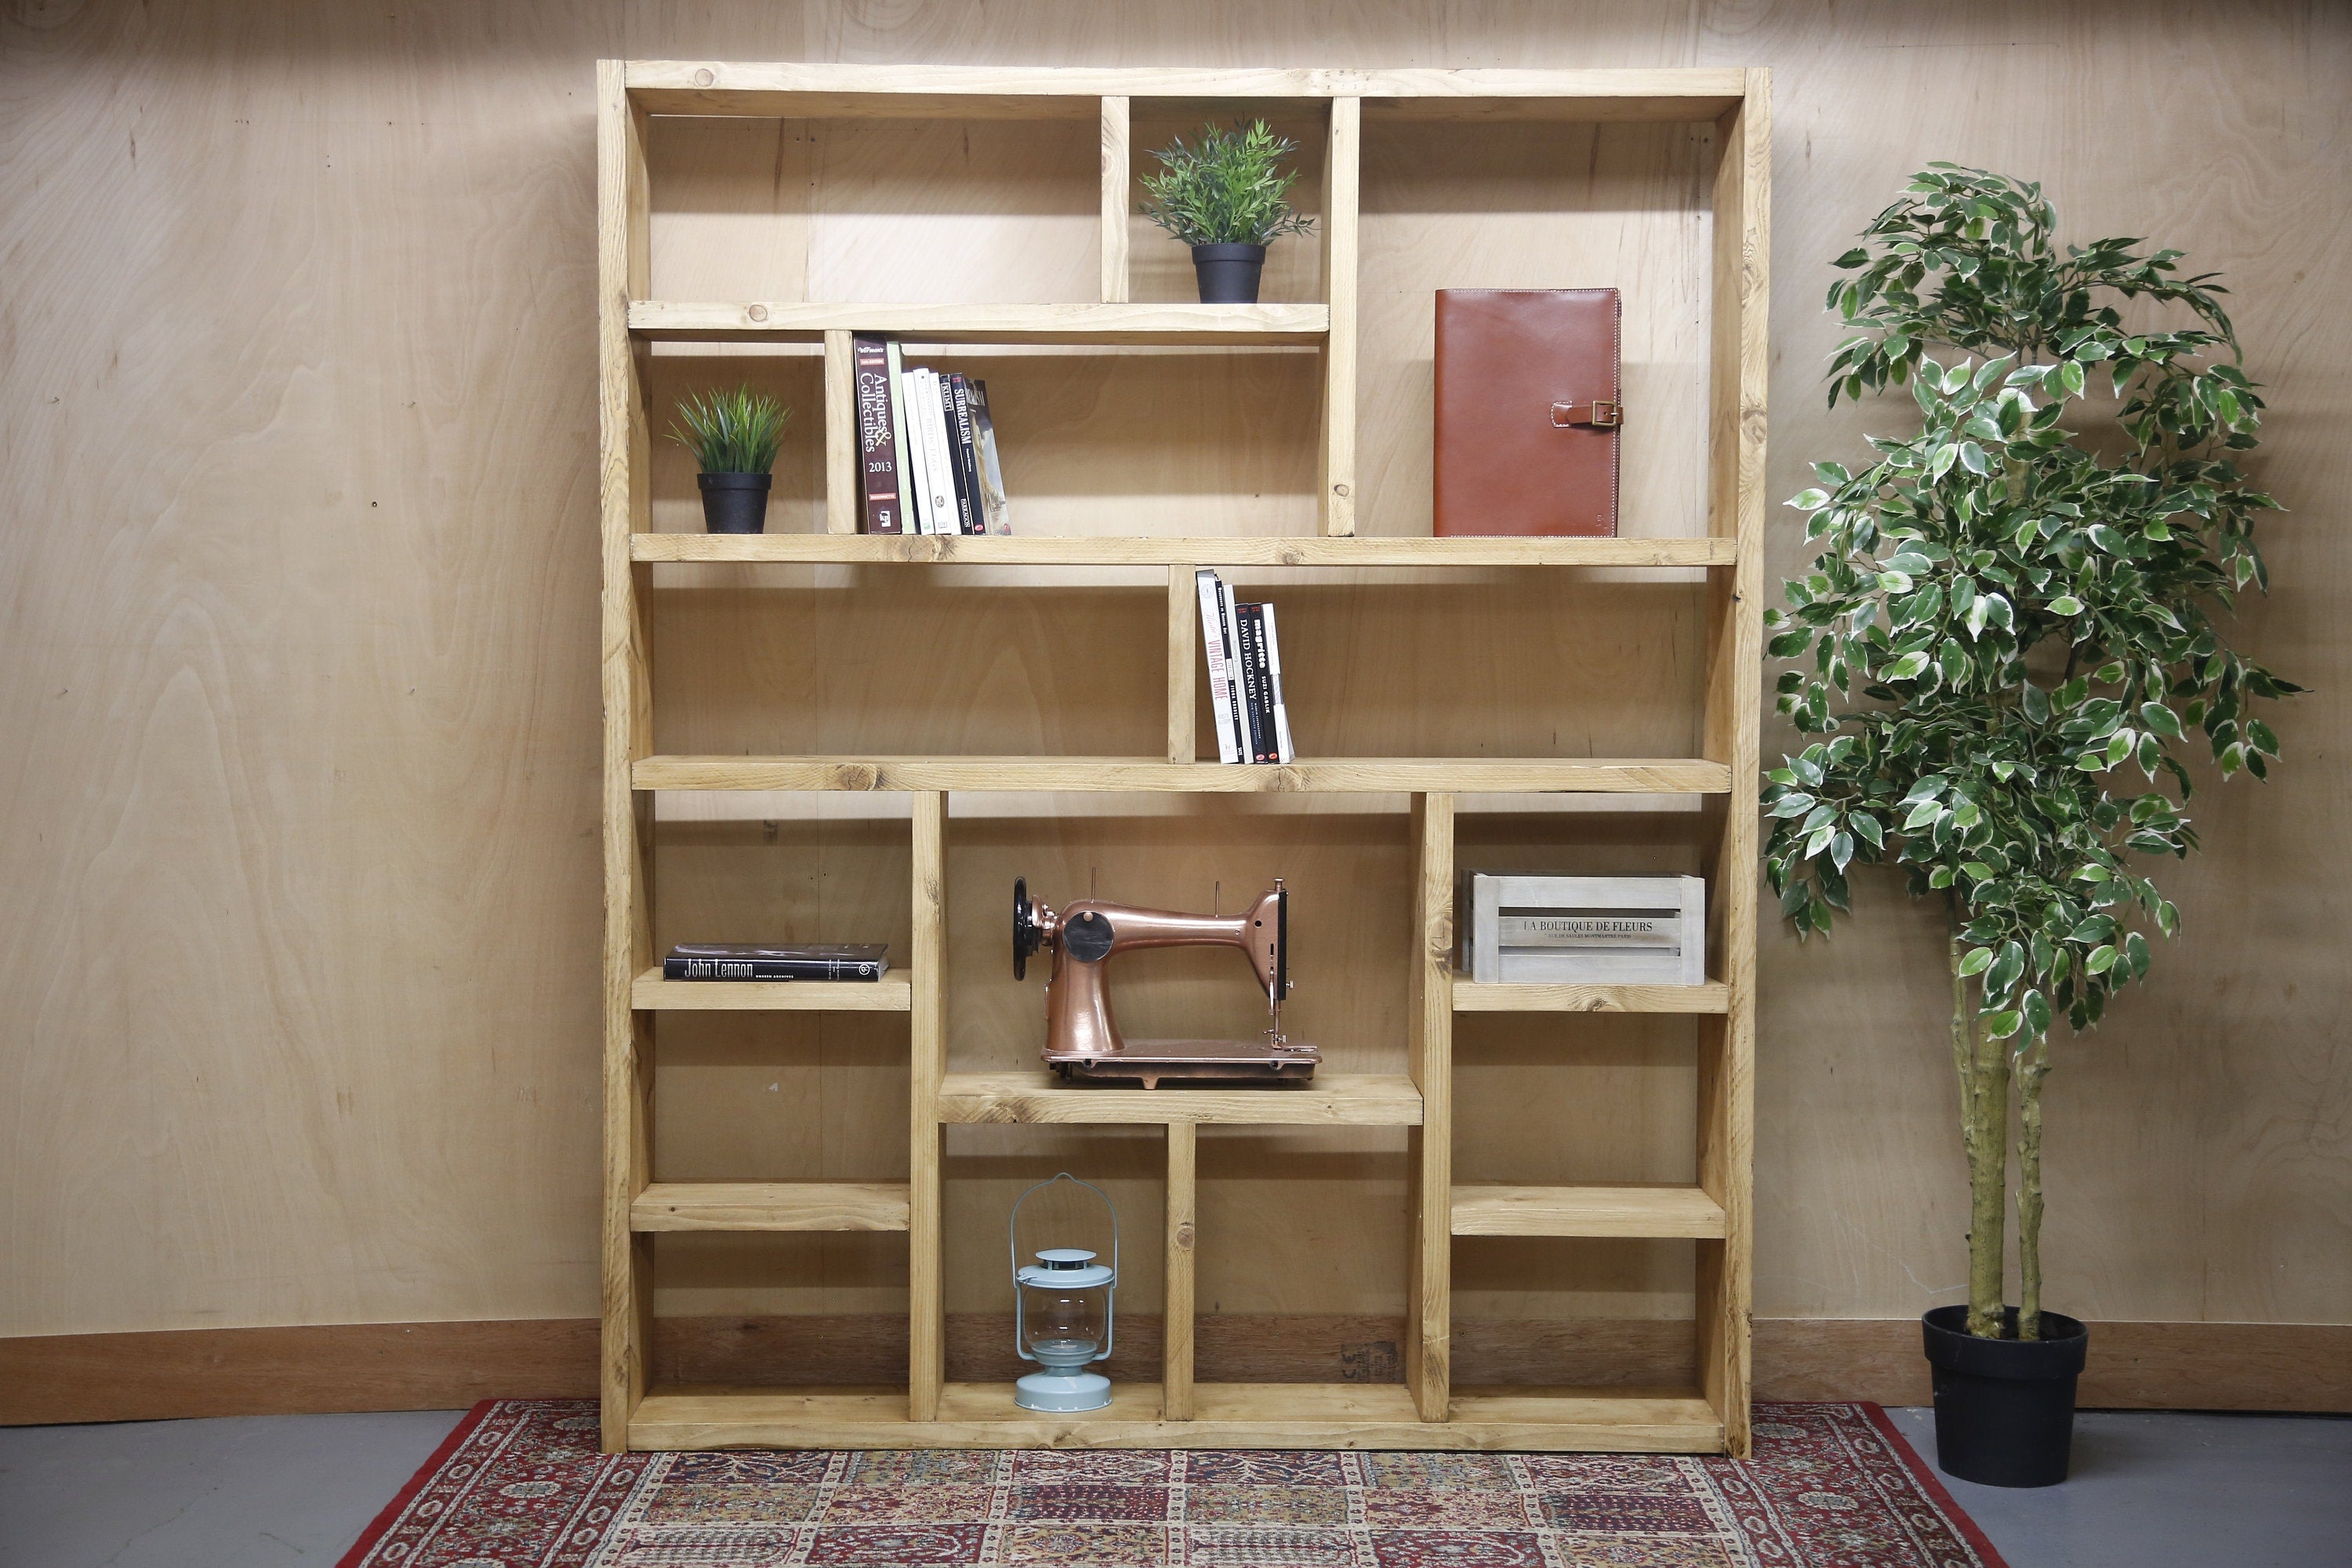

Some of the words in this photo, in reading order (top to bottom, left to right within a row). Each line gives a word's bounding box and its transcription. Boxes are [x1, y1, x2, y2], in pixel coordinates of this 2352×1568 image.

[860, 372, 878, 453] Collectibles
[873, 373, 887, 433] Antiques
[942, 385, 952, 409] KLIMT
[954, 388, 972, 445] SURREALISM
[875, 431, 892, 447] &
[869, 461, 892, 473] 2013
[1240, 619, 1250, 651] DAVID
[1254, 619, 1266, 669] magritte
[1208, 639, 1225, 673] VINTAGE
[1213, 677, 1229, 701] HOME
[1244, 652, 1258, 700] HOCKNEY
[1524, 921, 1536, 931] LA
[1540, 920, 1593, 933] BOUTIQUE
[1595, 921, 1610, 931] DE
[1613, 921, 1653, 931] FLEURS
[684, 958, 711, 978] John
[714, 958, 753, 978] Lennon
